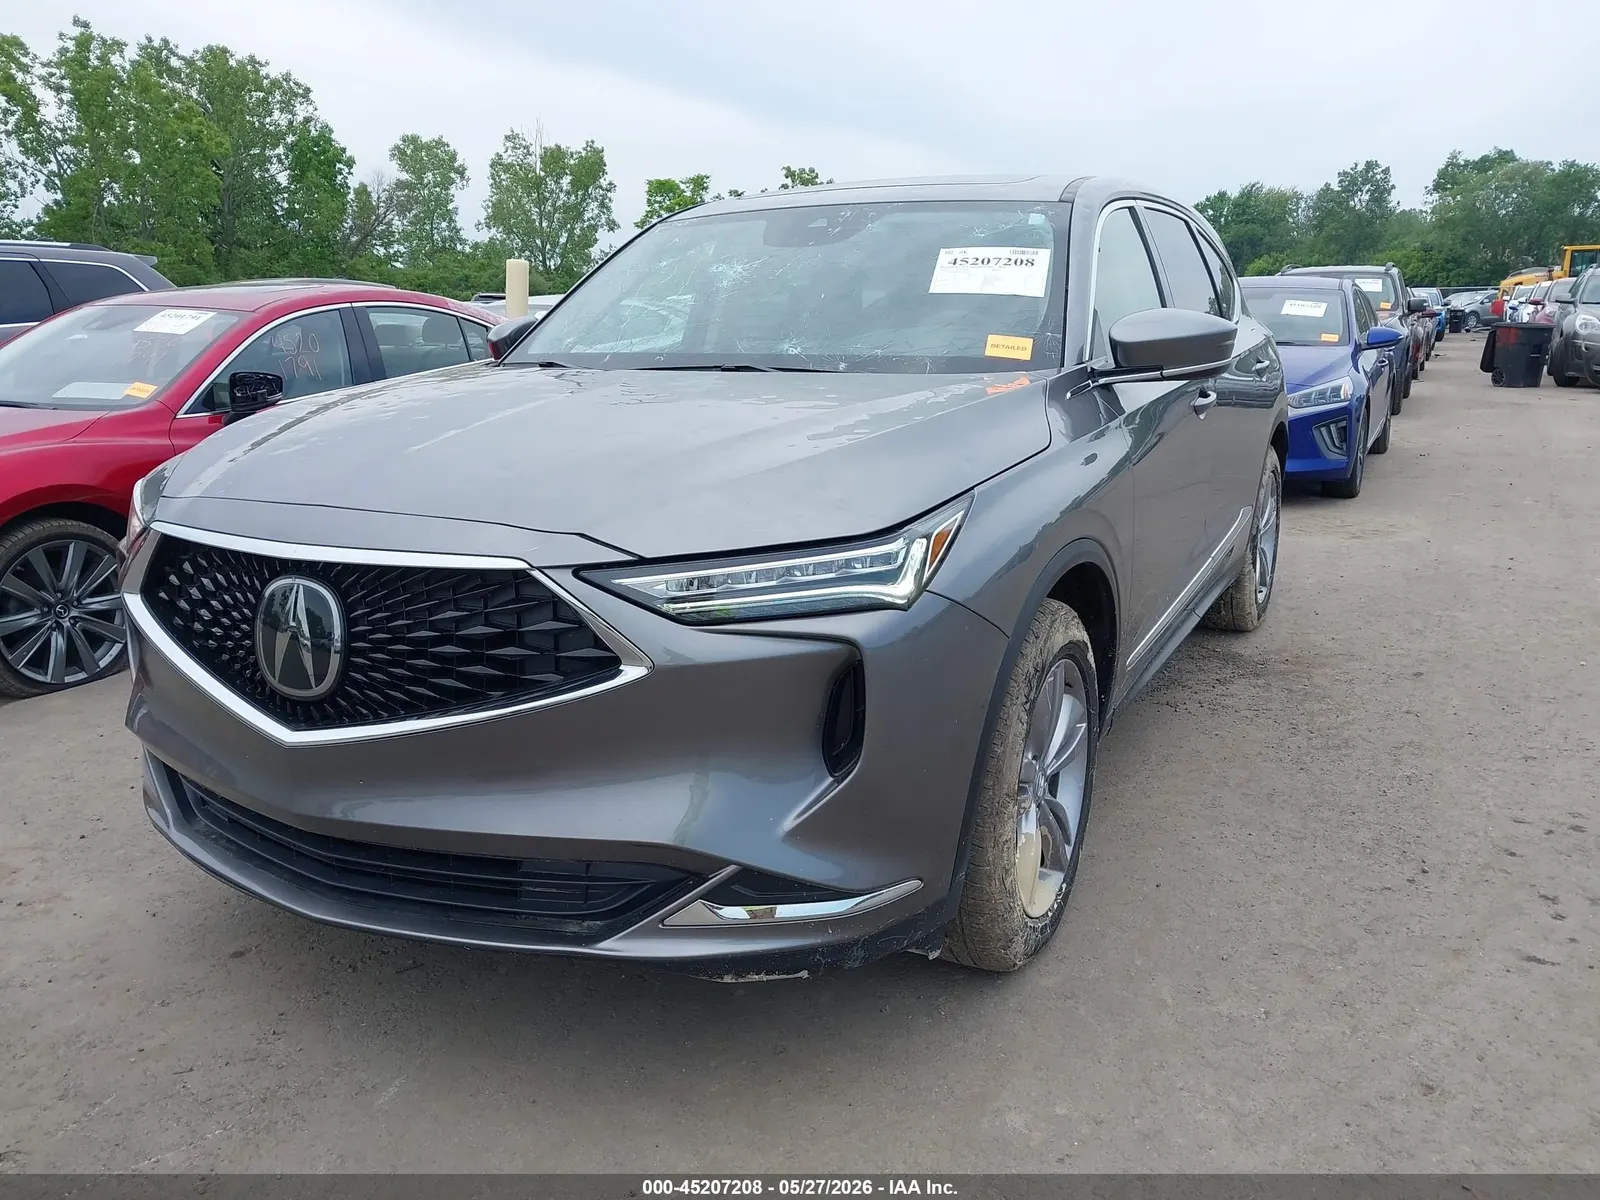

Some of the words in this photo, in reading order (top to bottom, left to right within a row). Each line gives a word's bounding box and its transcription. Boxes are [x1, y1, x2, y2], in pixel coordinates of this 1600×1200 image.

[948, 257, 1035, 267] 45207208
[270, 332, 320, 355] 4520
[990, 343, 1028, 352] DETAILED
[278, 355, 322, 381] 1791
